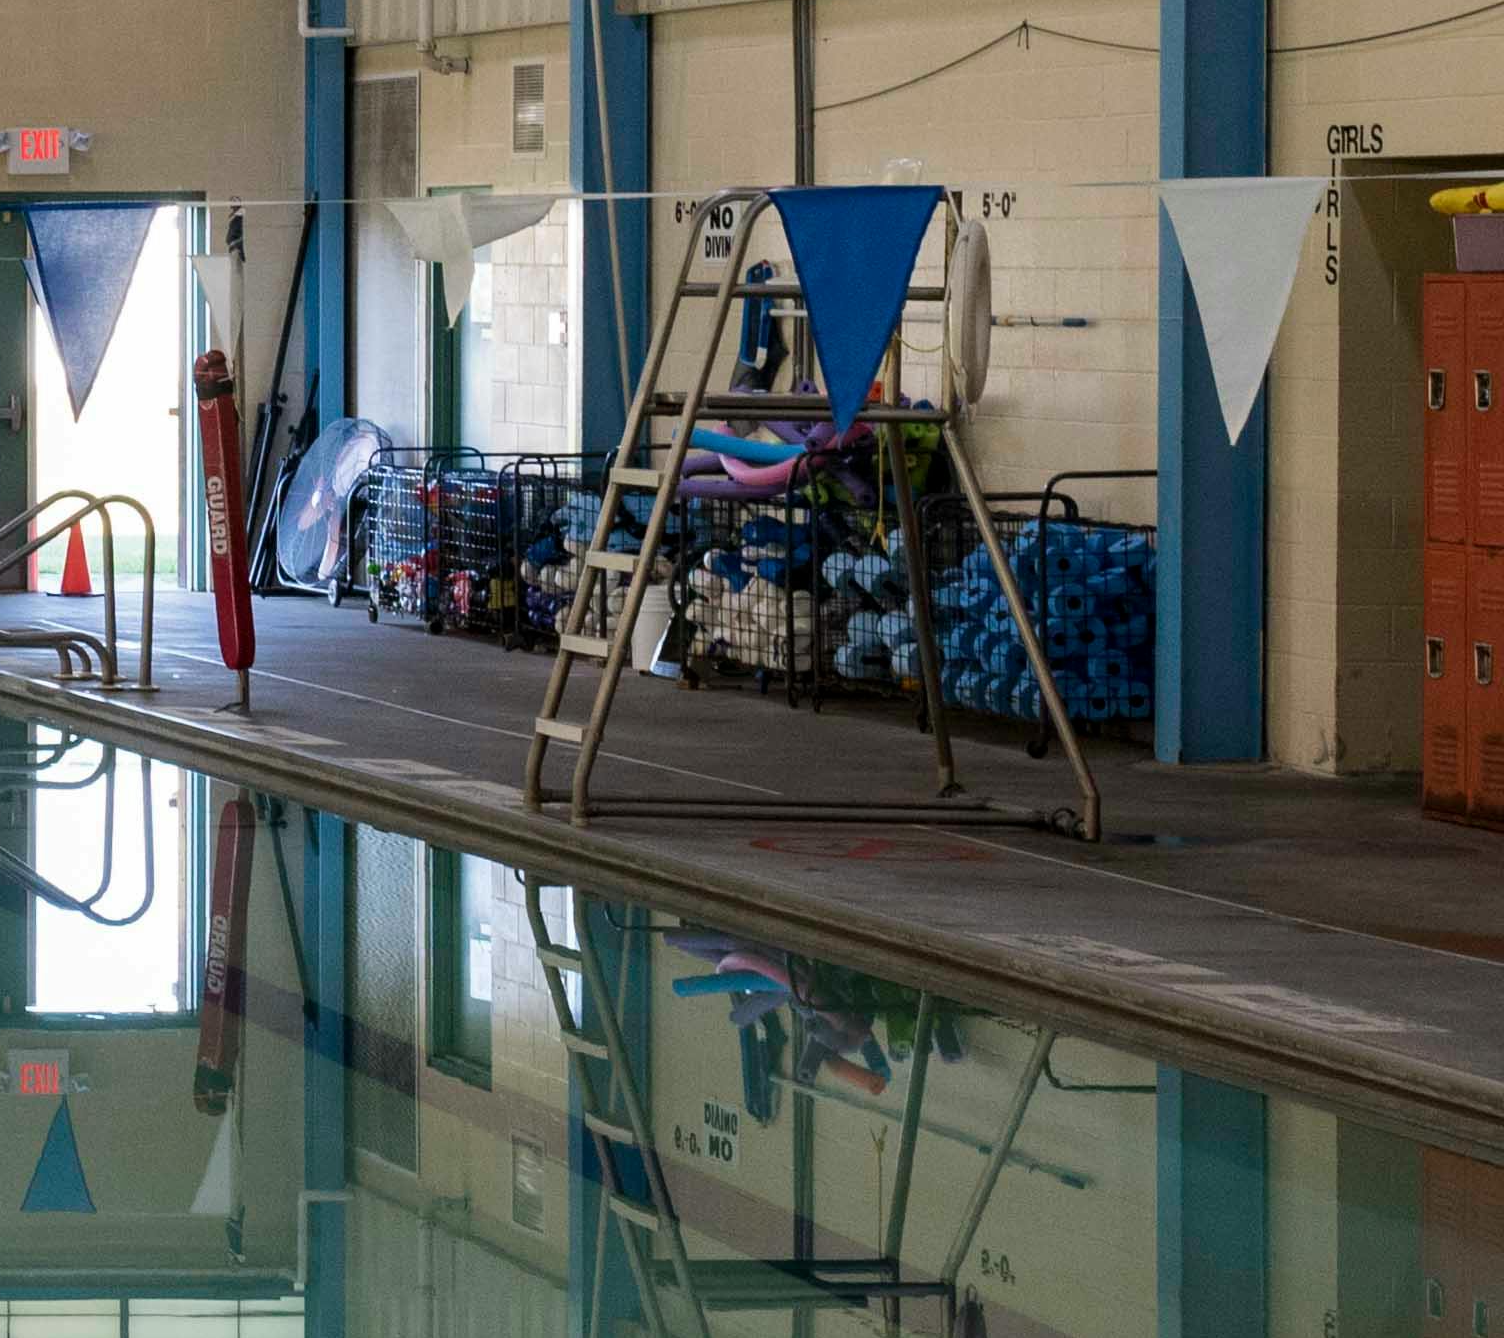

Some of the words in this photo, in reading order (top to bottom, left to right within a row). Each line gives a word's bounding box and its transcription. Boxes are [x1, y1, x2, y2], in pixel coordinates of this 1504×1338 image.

[21, 129, 59, 160] EXIT
[1327, 125, 1383, 154] GIRLS
[710, 205, 733, 229] NO
[705, 235, 735, 258] DIVIN
[206, 476, 228, 555] GUARD
